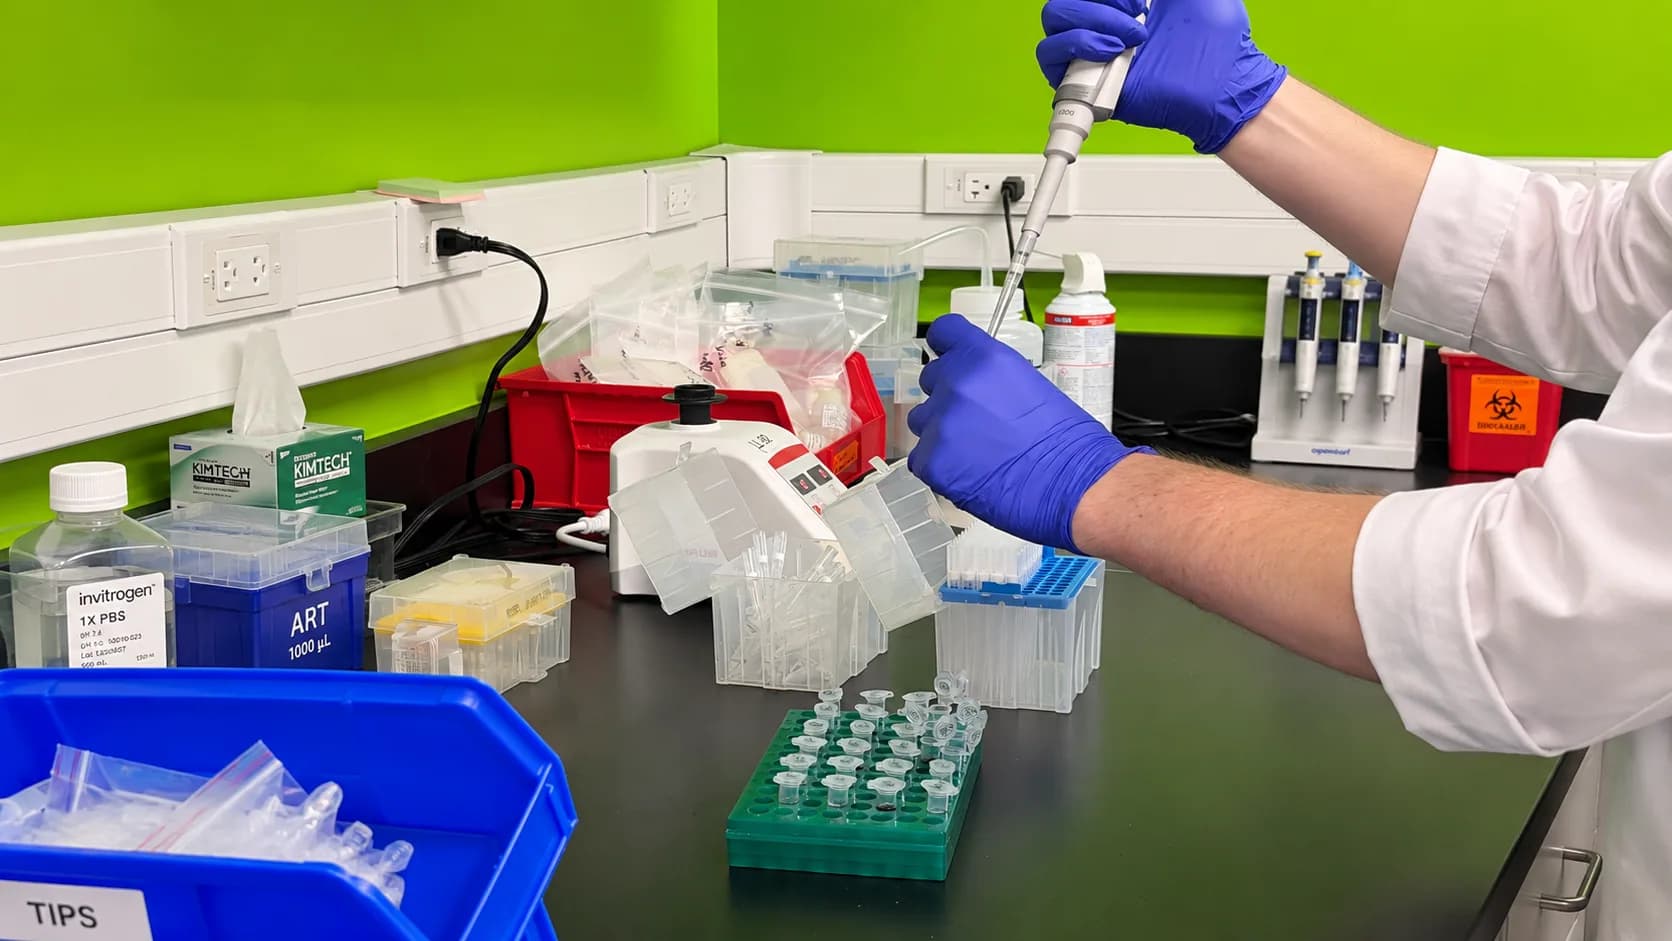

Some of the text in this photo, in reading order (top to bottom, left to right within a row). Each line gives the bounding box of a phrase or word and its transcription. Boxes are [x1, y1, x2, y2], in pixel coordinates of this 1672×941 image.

[193, 462, 250, 479] KIMTECH
[294, 453, 350, 479] KIMTECH
[80, 610, 126, 627] 1X PBS
[290, 601, 329, 638] ART
[289, 639, 315, 660] 1000
[26, 900, 98, 929] TIPS
